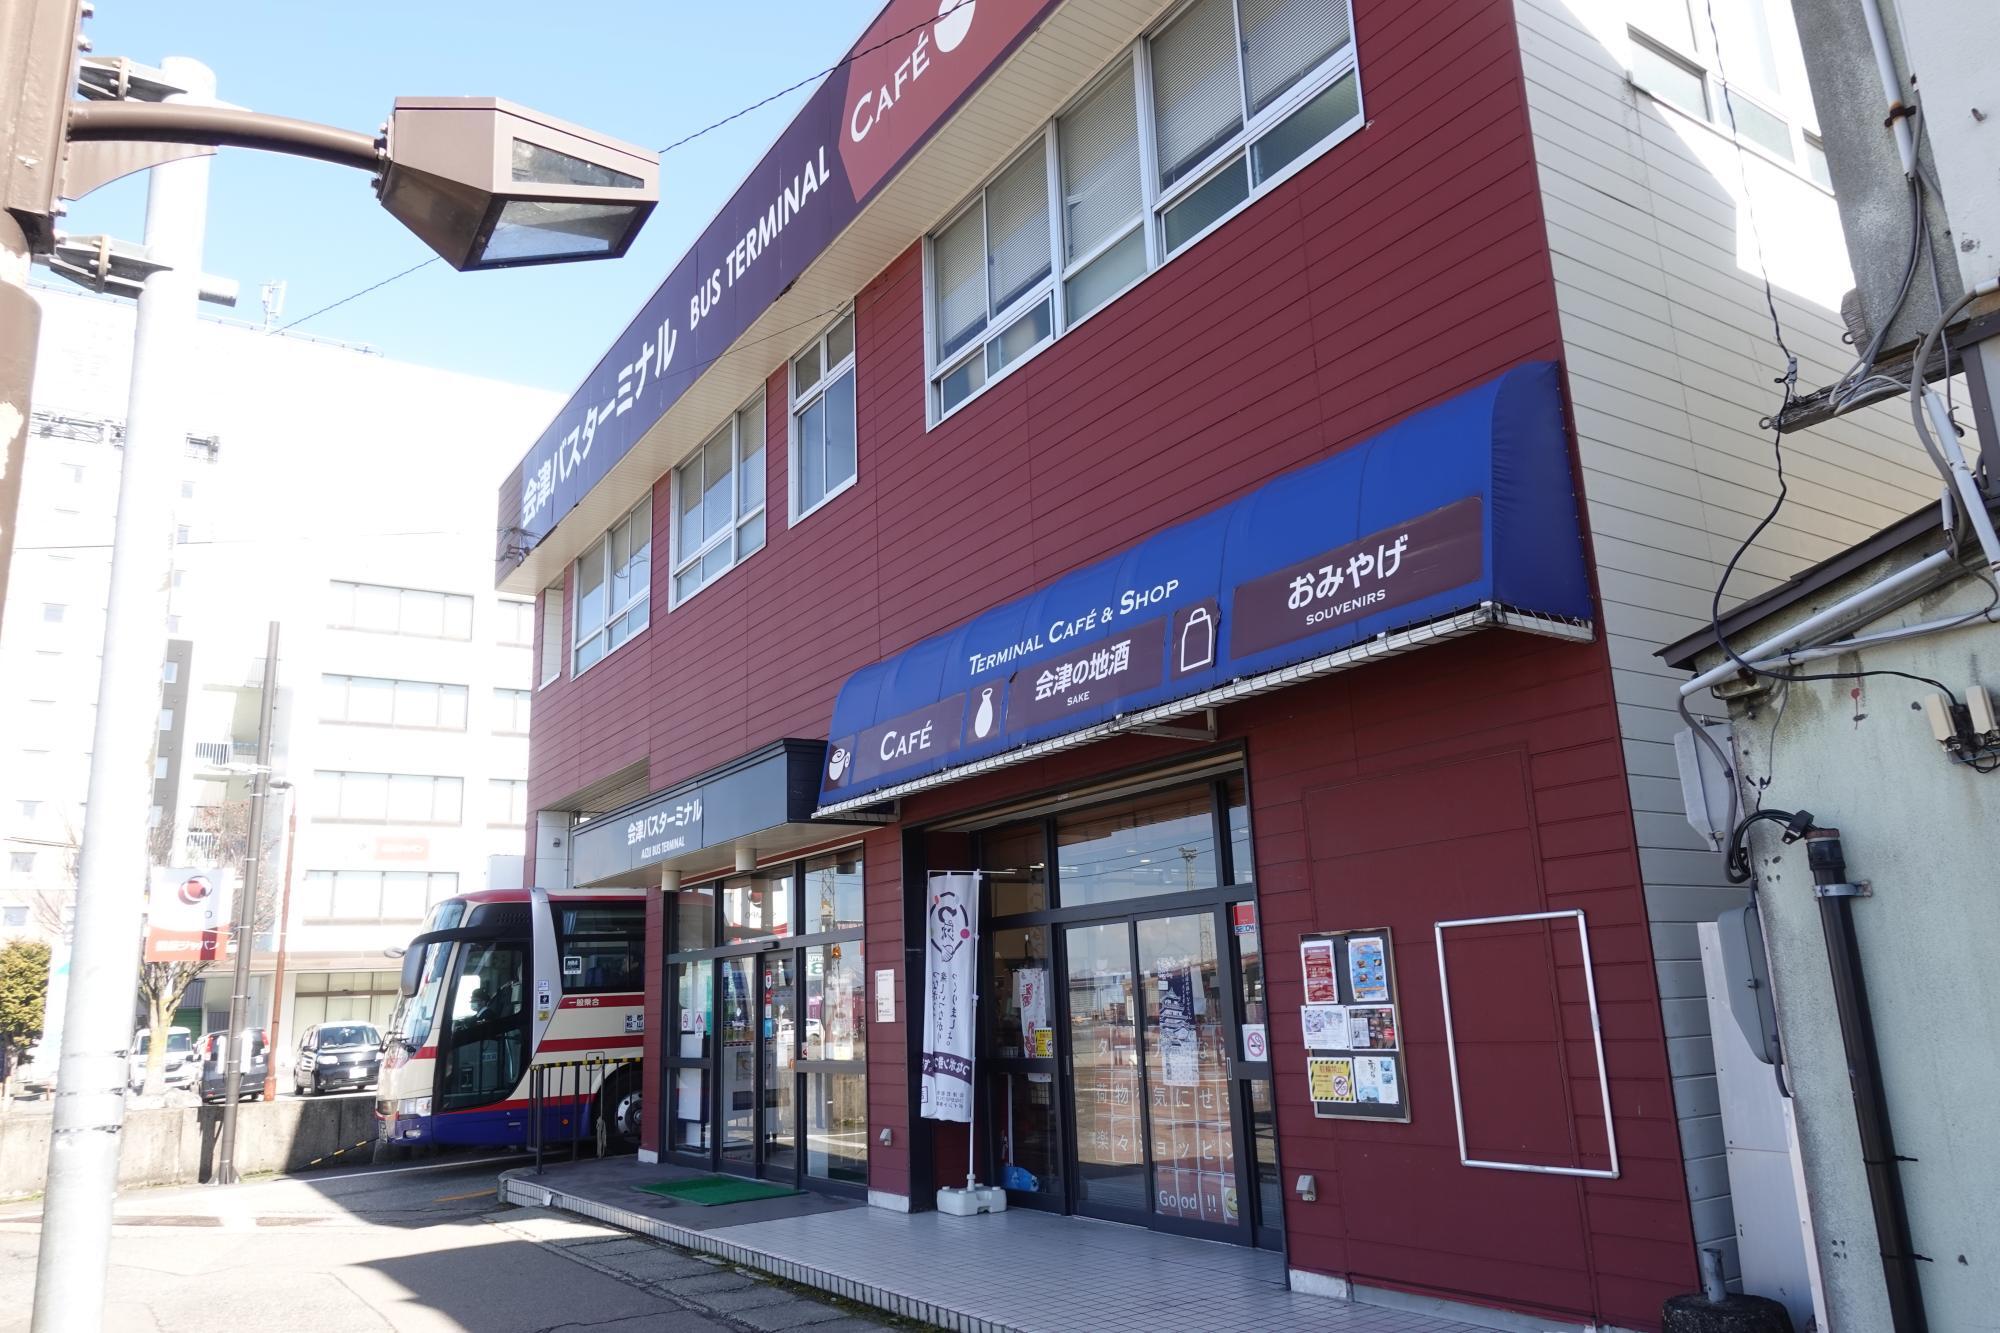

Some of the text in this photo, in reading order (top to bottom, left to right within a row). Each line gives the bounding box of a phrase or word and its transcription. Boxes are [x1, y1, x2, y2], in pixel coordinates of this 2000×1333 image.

[851, 31, 930, 143] CAFÉ
[522, 145, 830, 528] 会津バスターミナル BUS TERMINAL
[1288, 534, 1408, 610] おみやげ
[969, 635, 1044, 676] TERMINAL
[1101, 607, 1114, 624] &
[1120, 579, 1179, 615] SHOP
[1306, 589, 1386, 625] SOUVENIRS
[1034, 640, 1131, 701] 会津の地酒
[1066, 691, 1090, 706] SAKE
[880, 719, 934, 761] CAFÉ
[627, 799, 702, 846] 会津バスターミナル
[652, 843, 661, 856] BUS
[662, 836, 685, 853] TERMINAL
